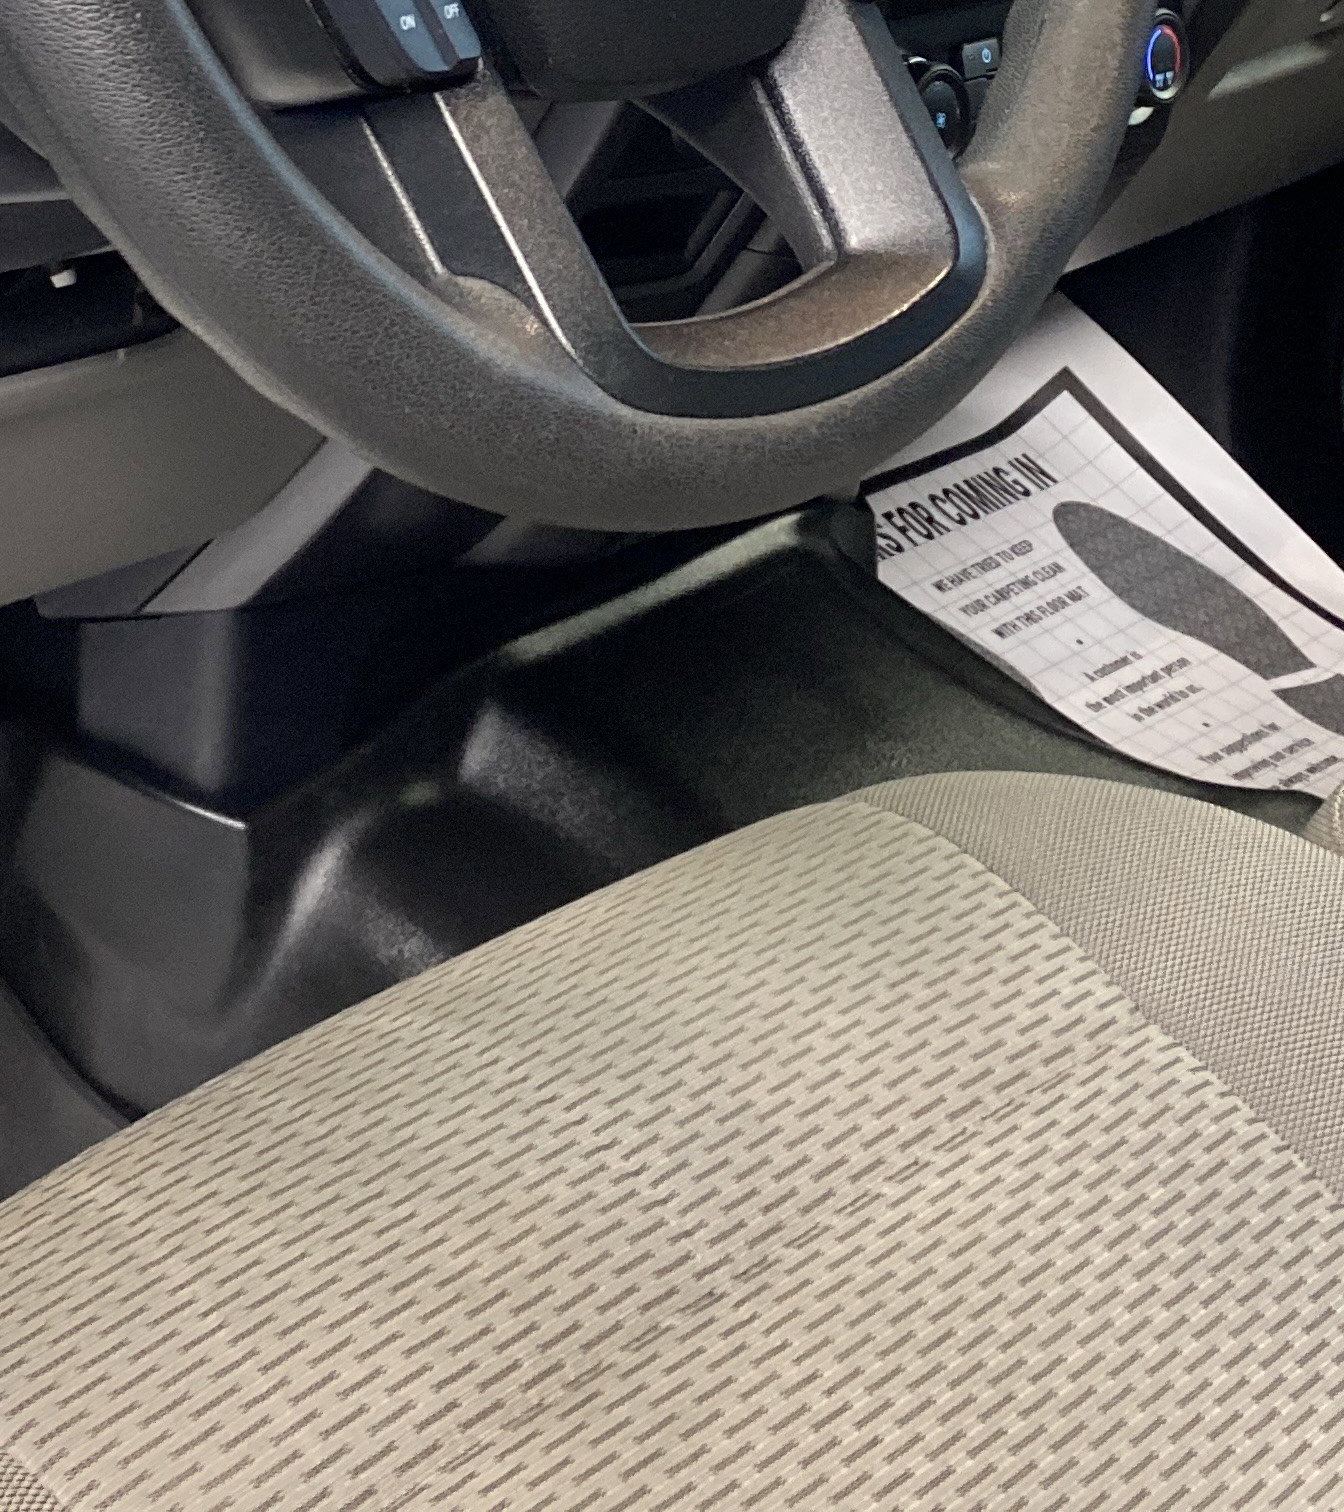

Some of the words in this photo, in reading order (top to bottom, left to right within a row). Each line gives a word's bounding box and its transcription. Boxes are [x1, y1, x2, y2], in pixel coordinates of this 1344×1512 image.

[399, 13, 416, 30] ON
[443, 2, 459, 19] OFF
[1008, 453, 1059, 491] IN
[928, 466, 1032, 526] COMING
[876, 523, 904, 562] S
[882, 501, 951, 547] FOR
